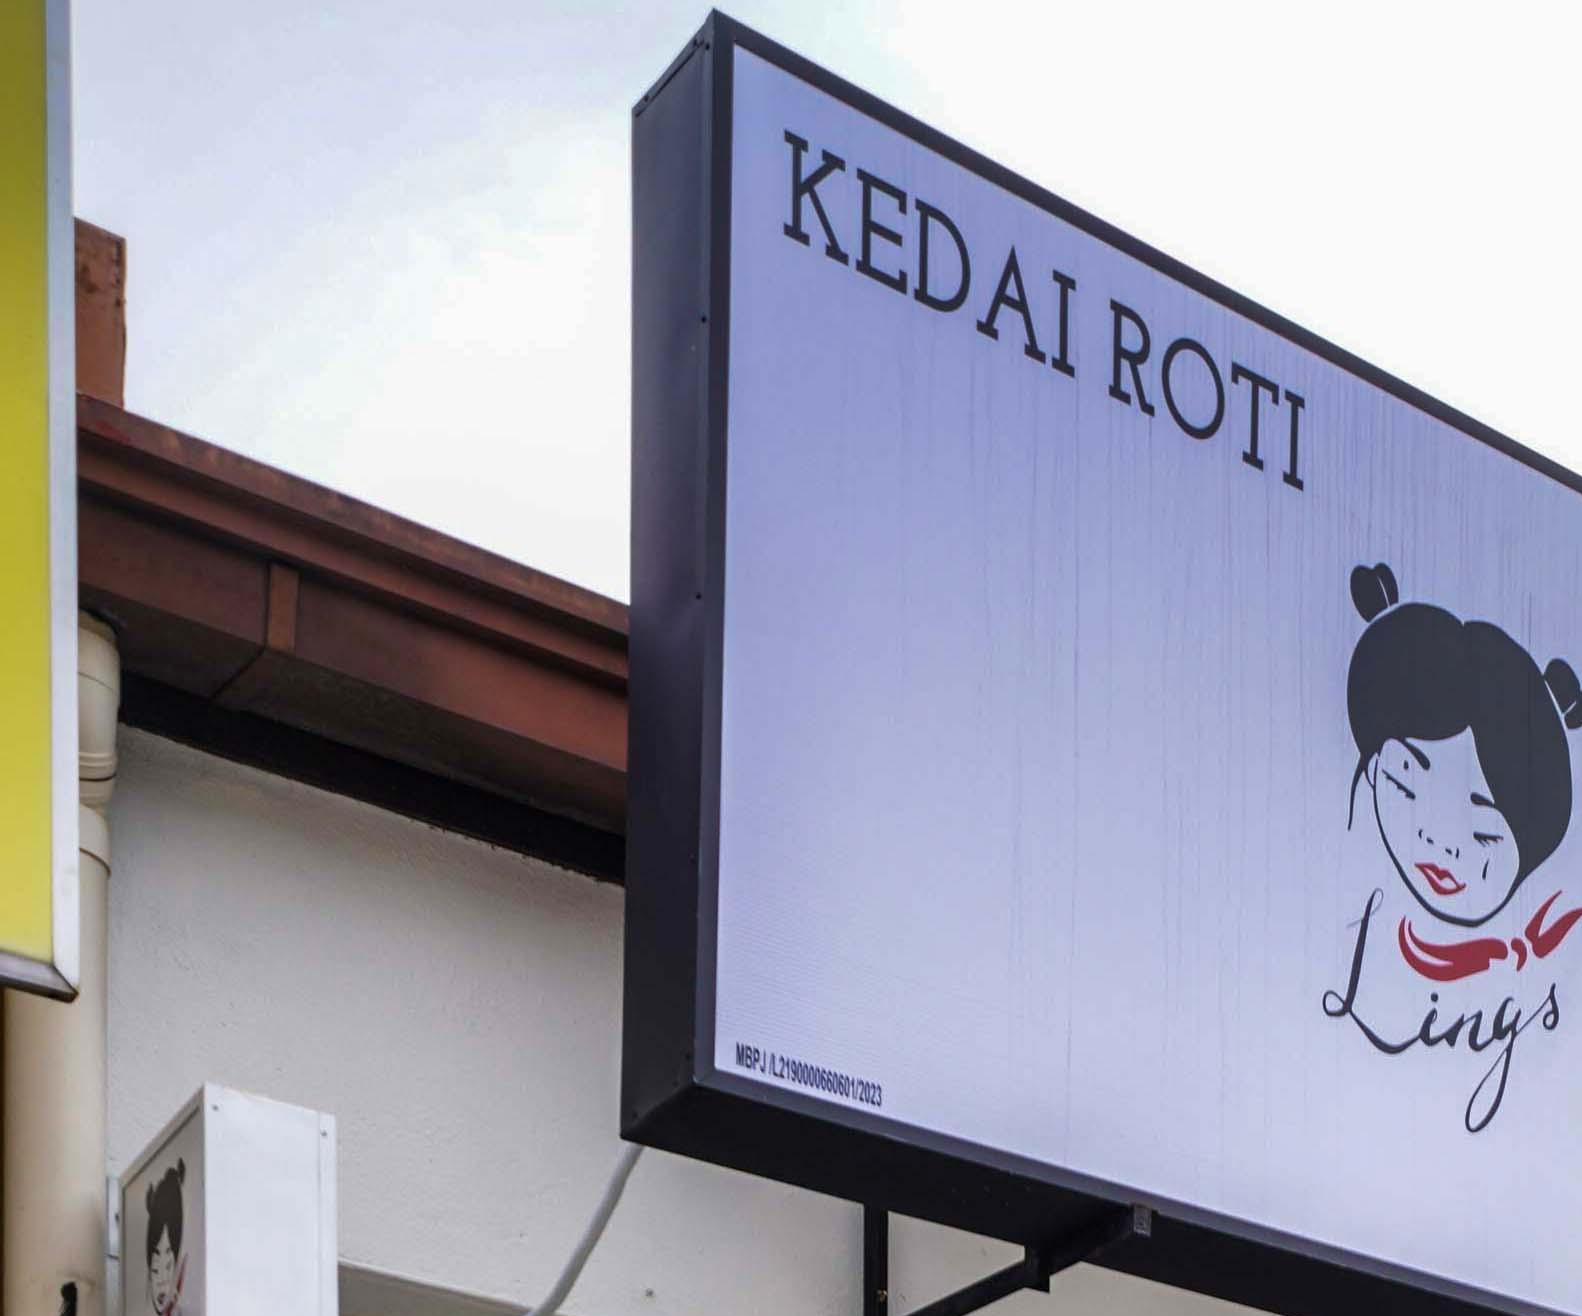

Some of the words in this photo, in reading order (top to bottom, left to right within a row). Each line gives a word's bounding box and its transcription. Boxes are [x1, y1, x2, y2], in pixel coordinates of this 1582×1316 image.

[783, 129, 1076, 378] KEDAI
[1109, 297, 1305, 491] ROTI
[735, 1041, 767, 1073] MBPJ
